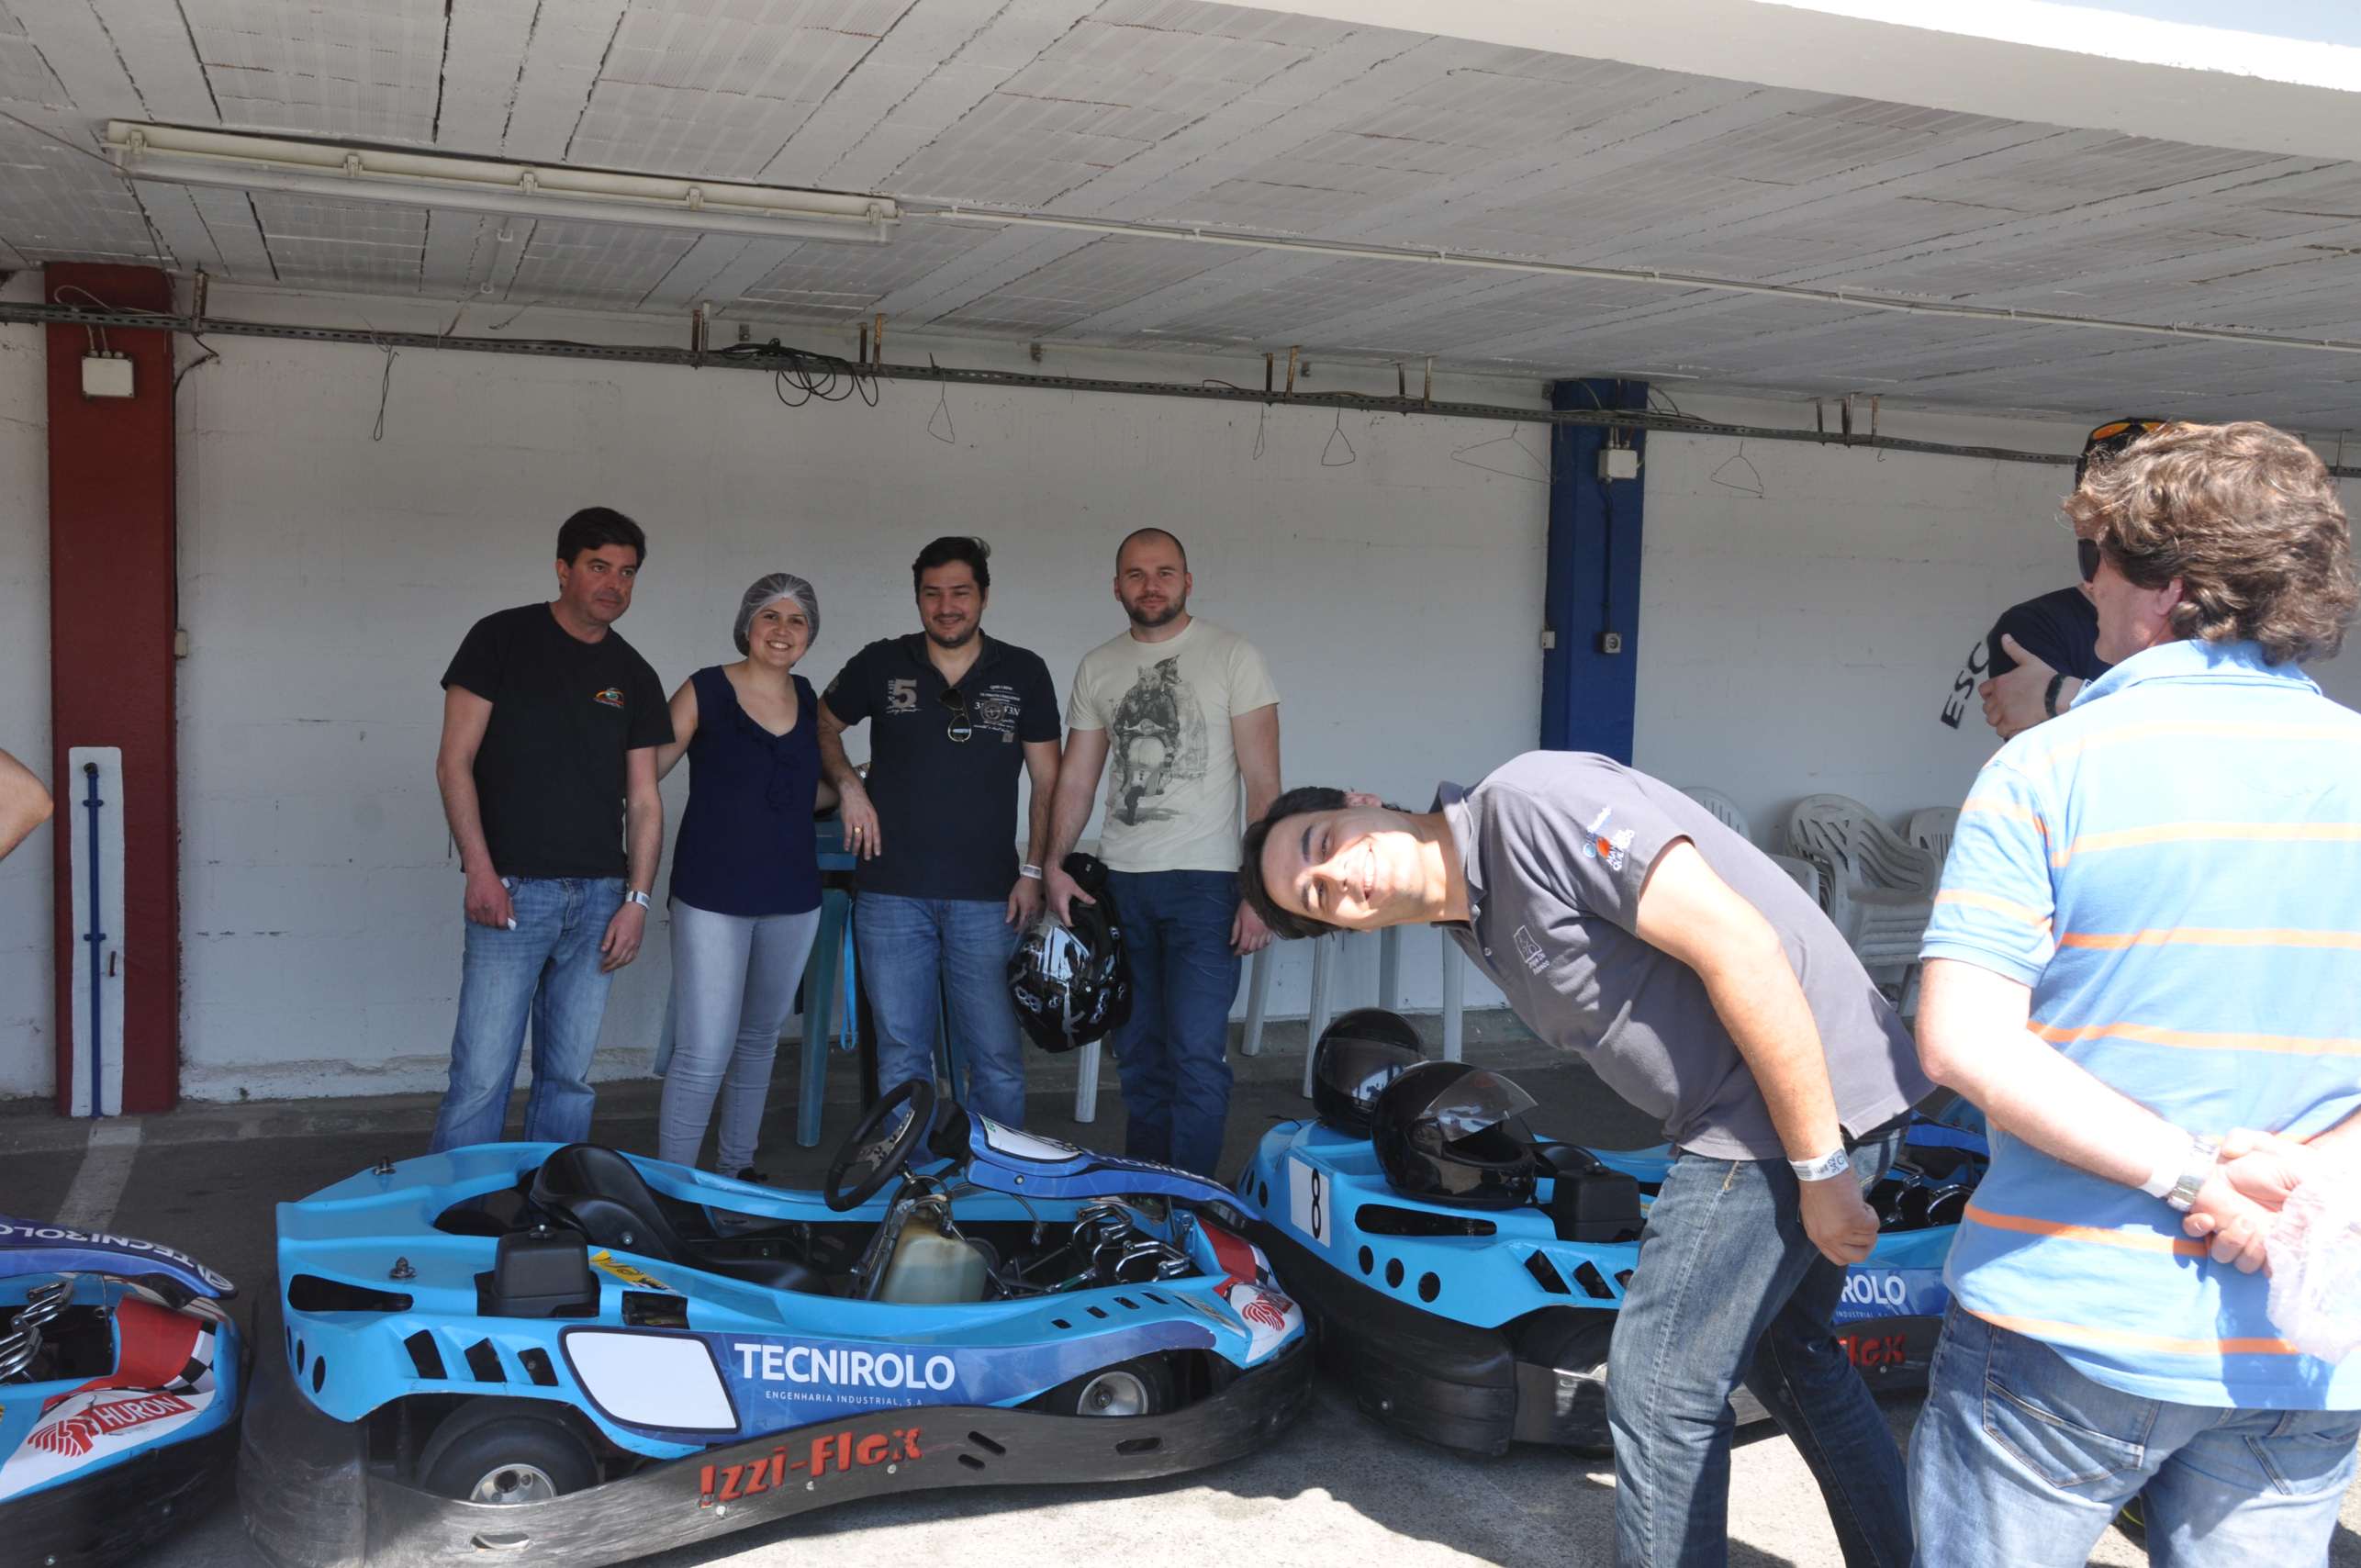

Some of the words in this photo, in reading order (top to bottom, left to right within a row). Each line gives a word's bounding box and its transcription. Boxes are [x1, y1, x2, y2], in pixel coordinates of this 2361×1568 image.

[1311, 1167, 1322, 1239] 8
[734, 1343, 956, 1392] TECNIROLO
[93, 1396, 186, 1428] HURON
[765, 1390, 833, 1403] ENGENHARIA
